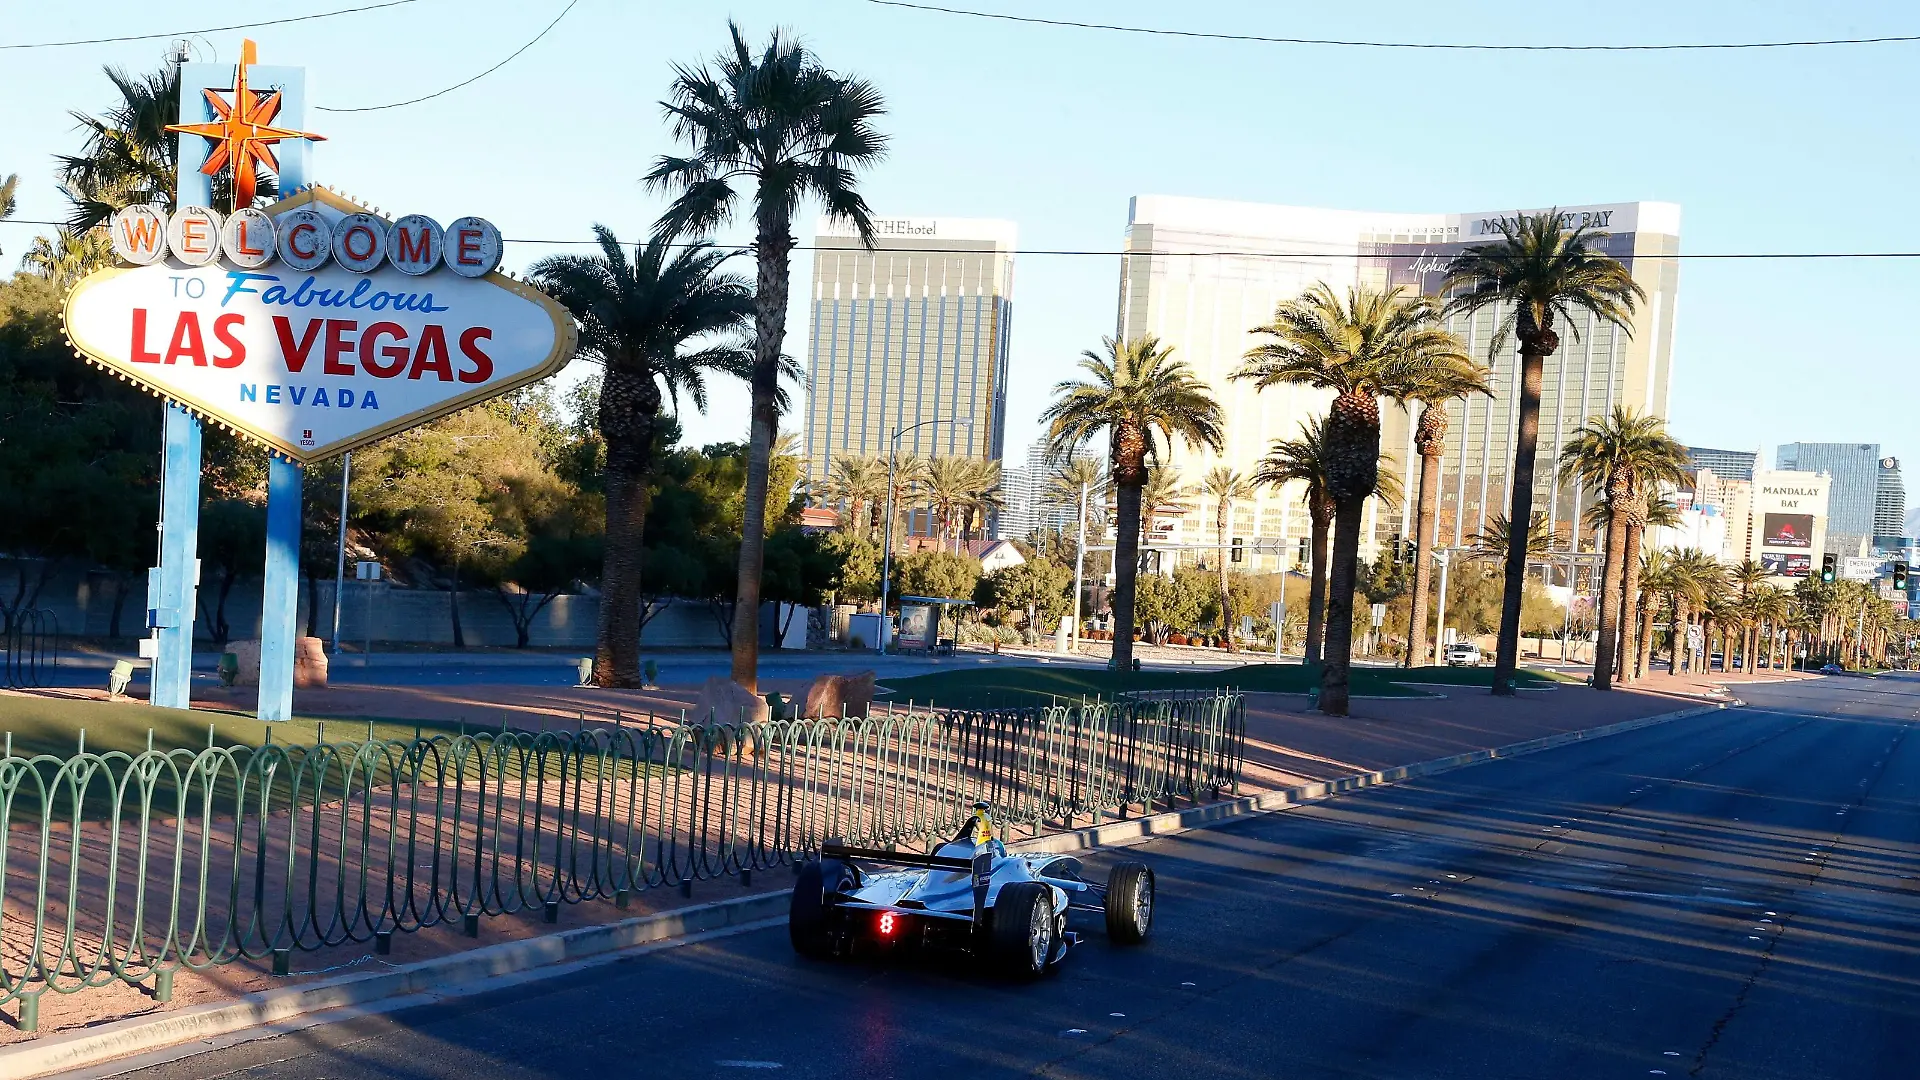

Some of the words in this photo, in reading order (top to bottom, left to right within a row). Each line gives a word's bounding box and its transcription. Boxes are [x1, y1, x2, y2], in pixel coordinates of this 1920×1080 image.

[1480, 212, 1577, 237] MANDY
[1582, 210, 1613, 229] BAY
[121, 216, 484, 266] WELCOME
[168, 275, 206, 300] TO
[221, 270, 450, 313] Fabulous
[130, 307, 247, 370] LAS
[271, 315, 494, 385] VEGAS
[239, 383, 380, 411] NEVADA
[1763, 486, 1819, 496] MANDALAY
[1781, 500, 1798, 508] BAY
